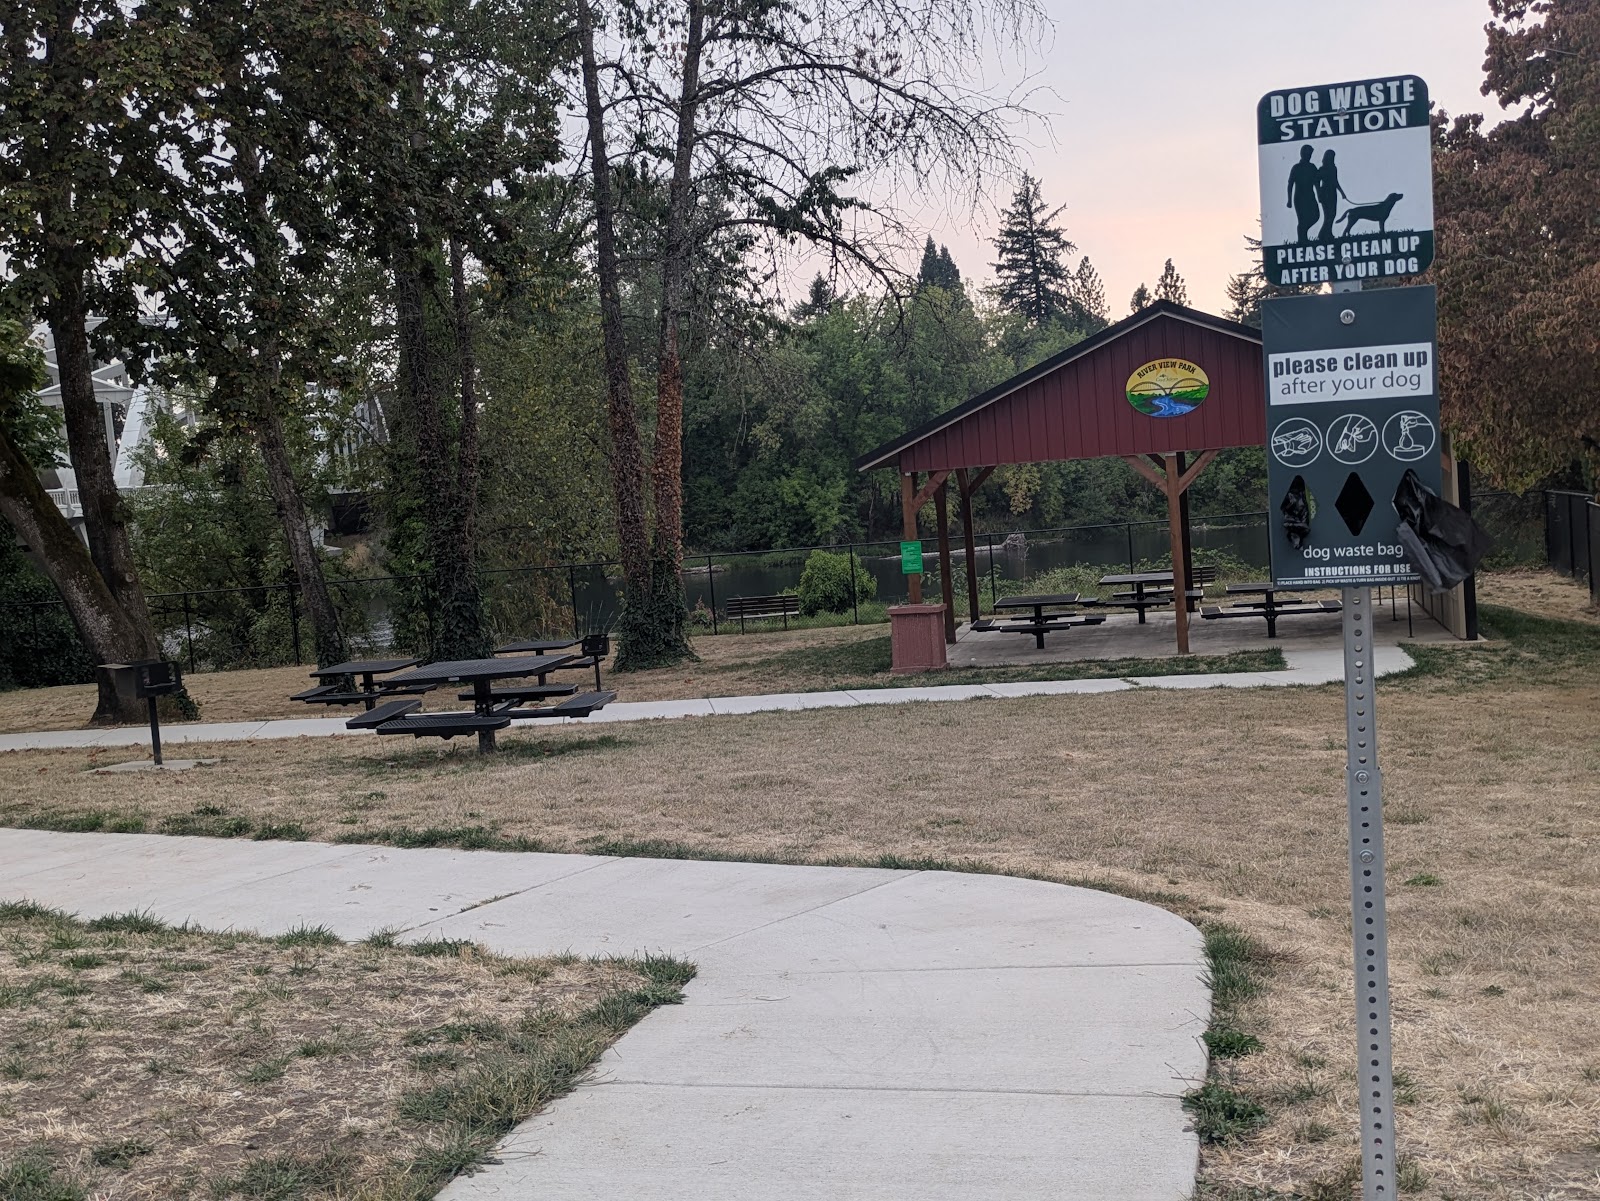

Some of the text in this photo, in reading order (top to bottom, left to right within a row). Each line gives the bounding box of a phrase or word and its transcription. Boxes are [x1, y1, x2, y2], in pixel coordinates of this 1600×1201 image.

[1270, 79, 1415, 118] DOG WASTE
[1280, 108, 1407, 141] STATION
[1277, 236, 1420, 264] PLEASE CLEAN UP
[1281, 257, 1418, 285] AFTER YOUR DOG
[1137, 361, 1196, 378] RIVER VIEW PARK
[1273, 350, 1428, 378] please clean up
[1281, 371, 1421, 396] after your dog
[1303, 542, 1404, 561] dog waste bag
[1304, 563, 1411, 577] INSTRUCTIONS FOR USE
